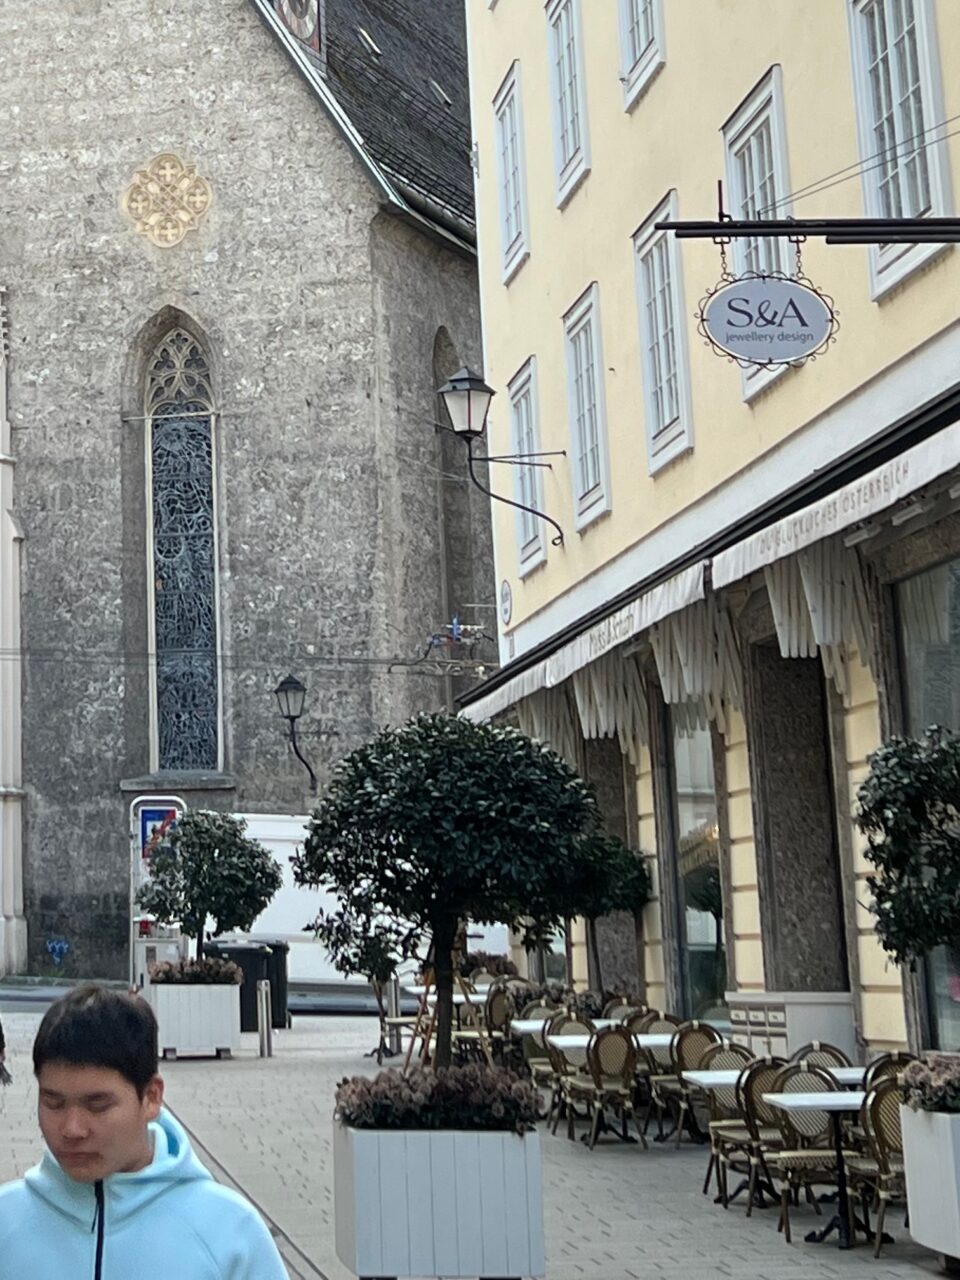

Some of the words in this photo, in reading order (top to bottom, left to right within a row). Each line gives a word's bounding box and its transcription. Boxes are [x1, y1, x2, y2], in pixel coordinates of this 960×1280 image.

[726, 297, 809, 328] S&A
[725, 331, 775, 344] jewellery
[777, 331, 814, 345] design
